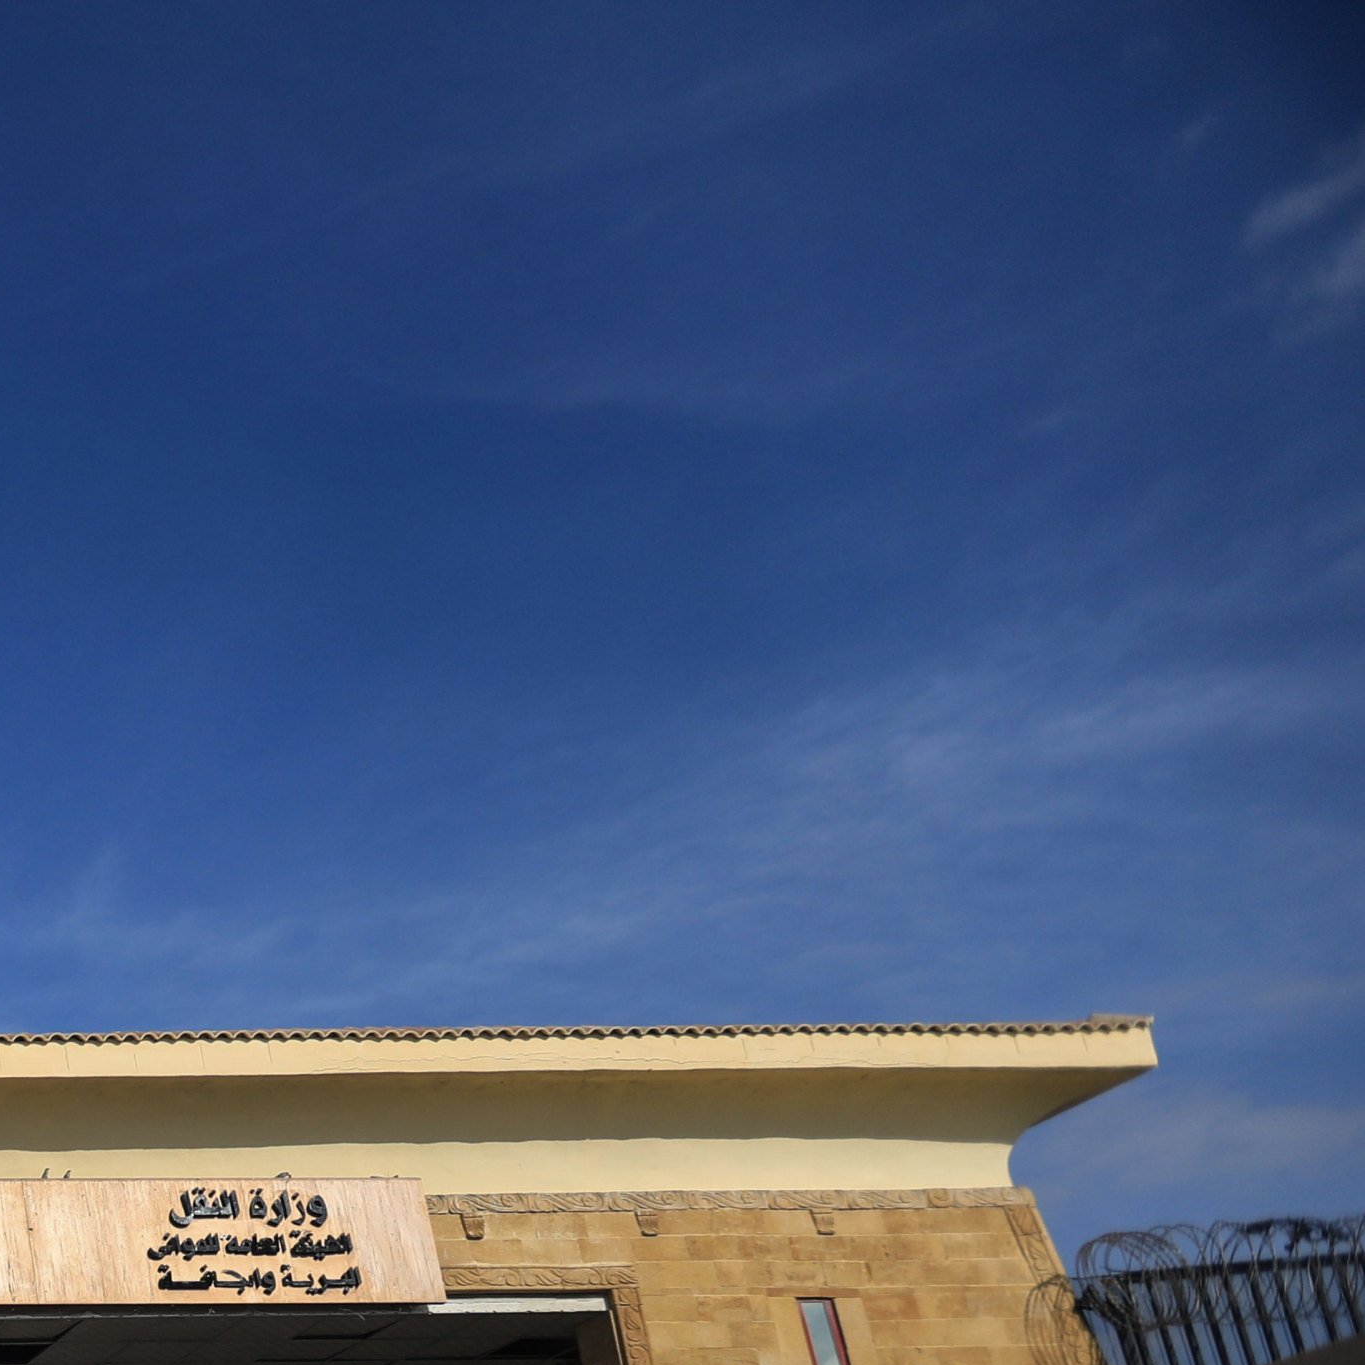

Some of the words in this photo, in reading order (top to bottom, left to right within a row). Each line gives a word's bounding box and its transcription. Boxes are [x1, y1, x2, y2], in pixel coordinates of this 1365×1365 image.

[168, 1186, 241, 1229] النقل
[248, 1187, 328, 1229] وزارة
[220, 1232, 287, 1257] العامة
[279, 1263, 363, 1296] البرية
